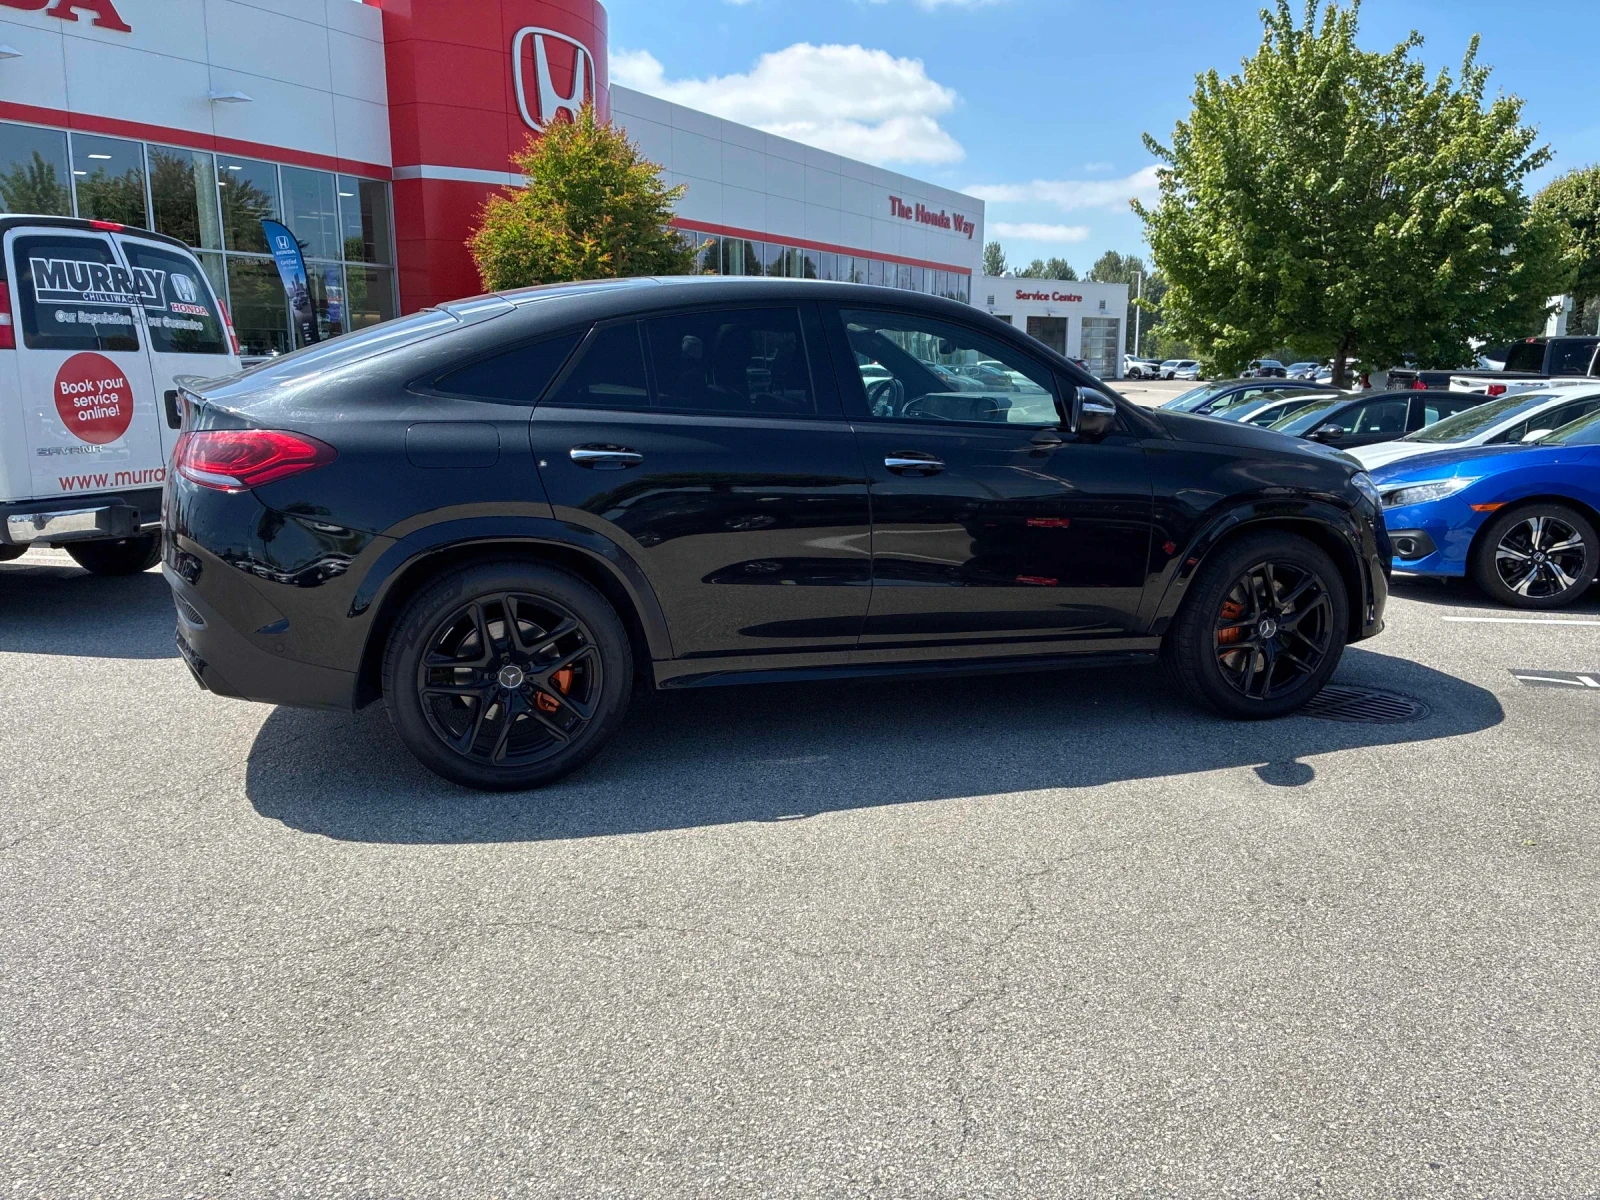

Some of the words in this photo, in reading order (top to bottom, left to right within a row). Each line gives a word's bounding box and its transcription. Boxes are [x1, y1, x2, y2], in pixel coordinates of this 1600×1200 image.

[889, 195, 913, 220] The
[915, 202, 951, 229] Honda
[952, 212, 975, 240] Way
[29, 257, 167, 300] MURRAY
[82, 291, 141, 304] CHILLIWACK
[1015, 289, 1050, 301] Service
[1051, 291, 1083, 303] Centre
[55, 310, 76, 324] Our
[171, 303, 210, 316] HONDA
[60, 378, 95, 395] Book
[96, 377, 124, 394] your
[73, 392, 119, 408] service
[78, 405, 120, 422] online!
